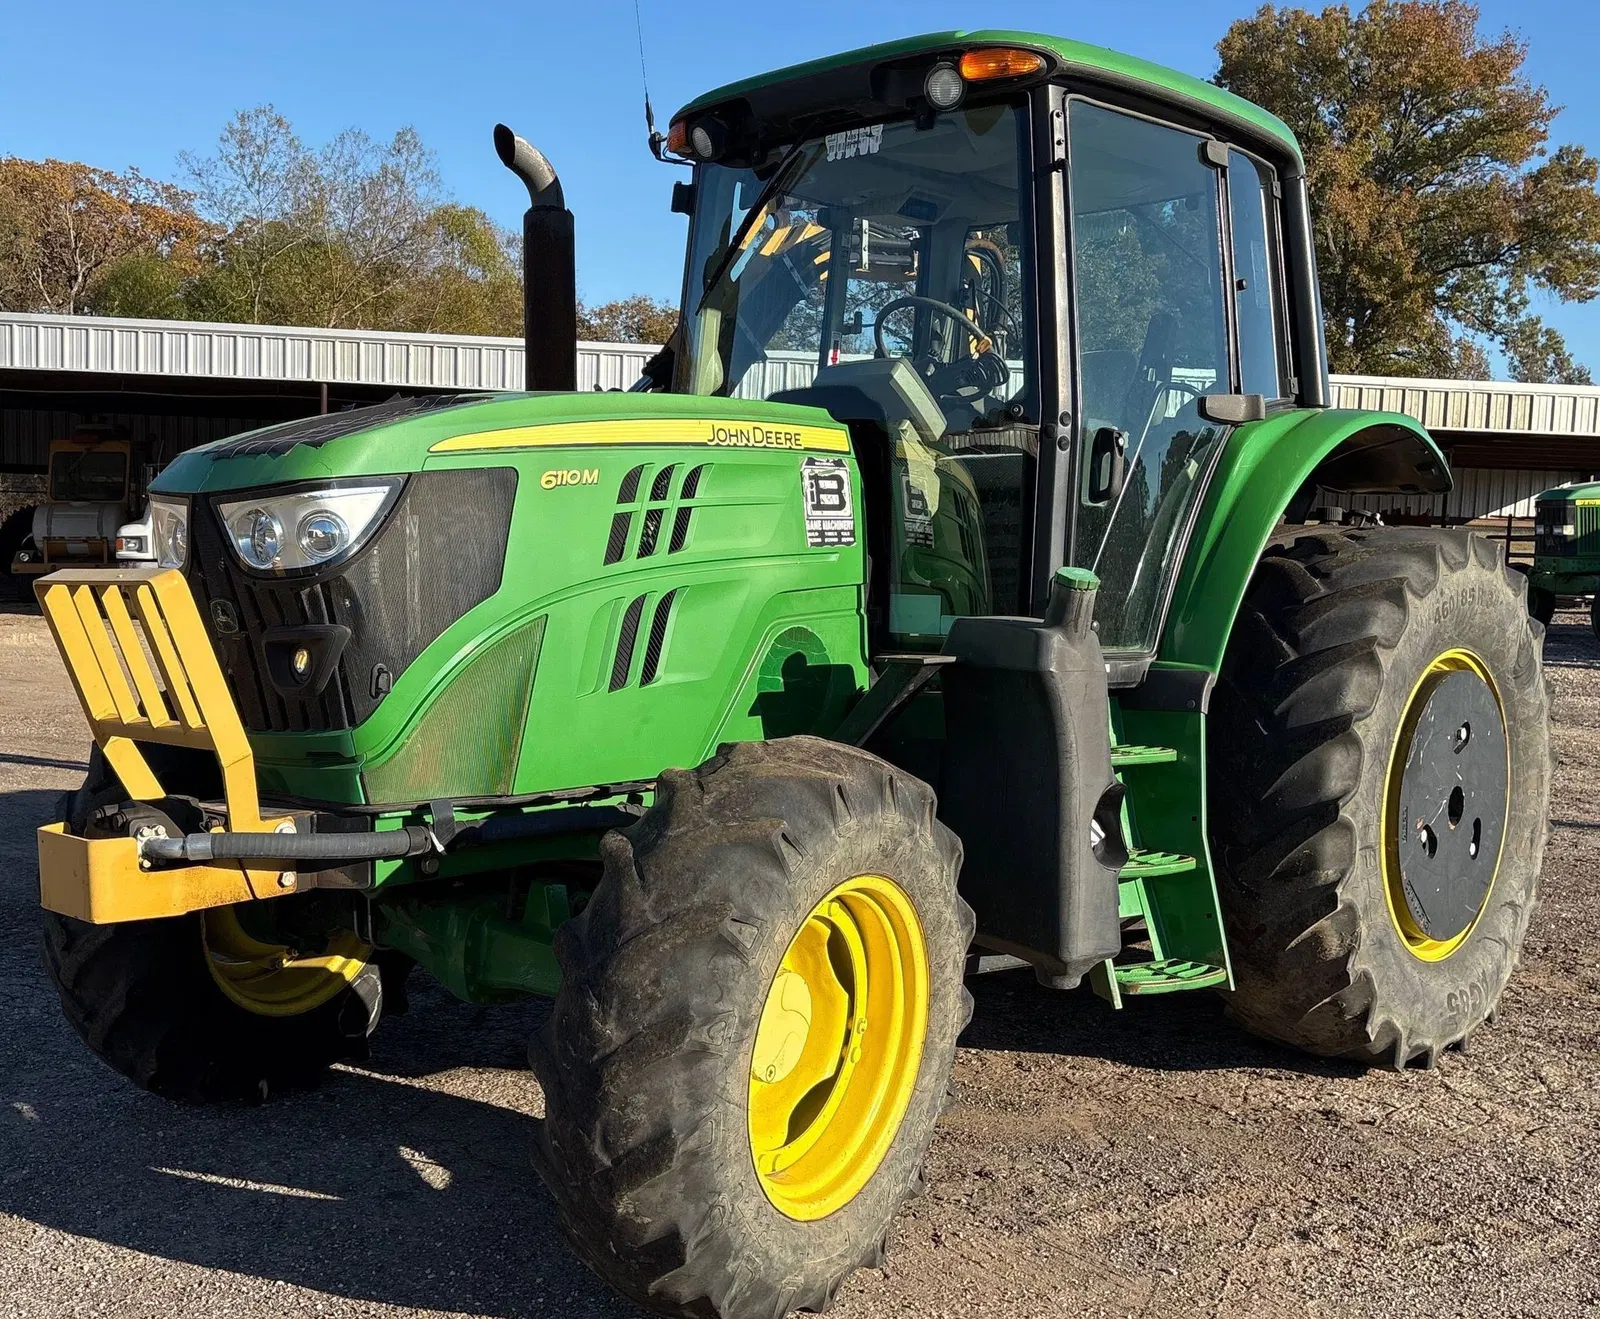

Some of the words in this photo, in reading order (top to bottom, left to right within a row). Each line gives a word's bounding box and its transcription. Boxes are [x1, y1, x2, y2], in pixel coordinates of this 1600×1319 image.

[707, 424, 750, 443] JOHN
[752, 426, 802, 446] DEERE
[540, 468, 599, 490] 6110M
